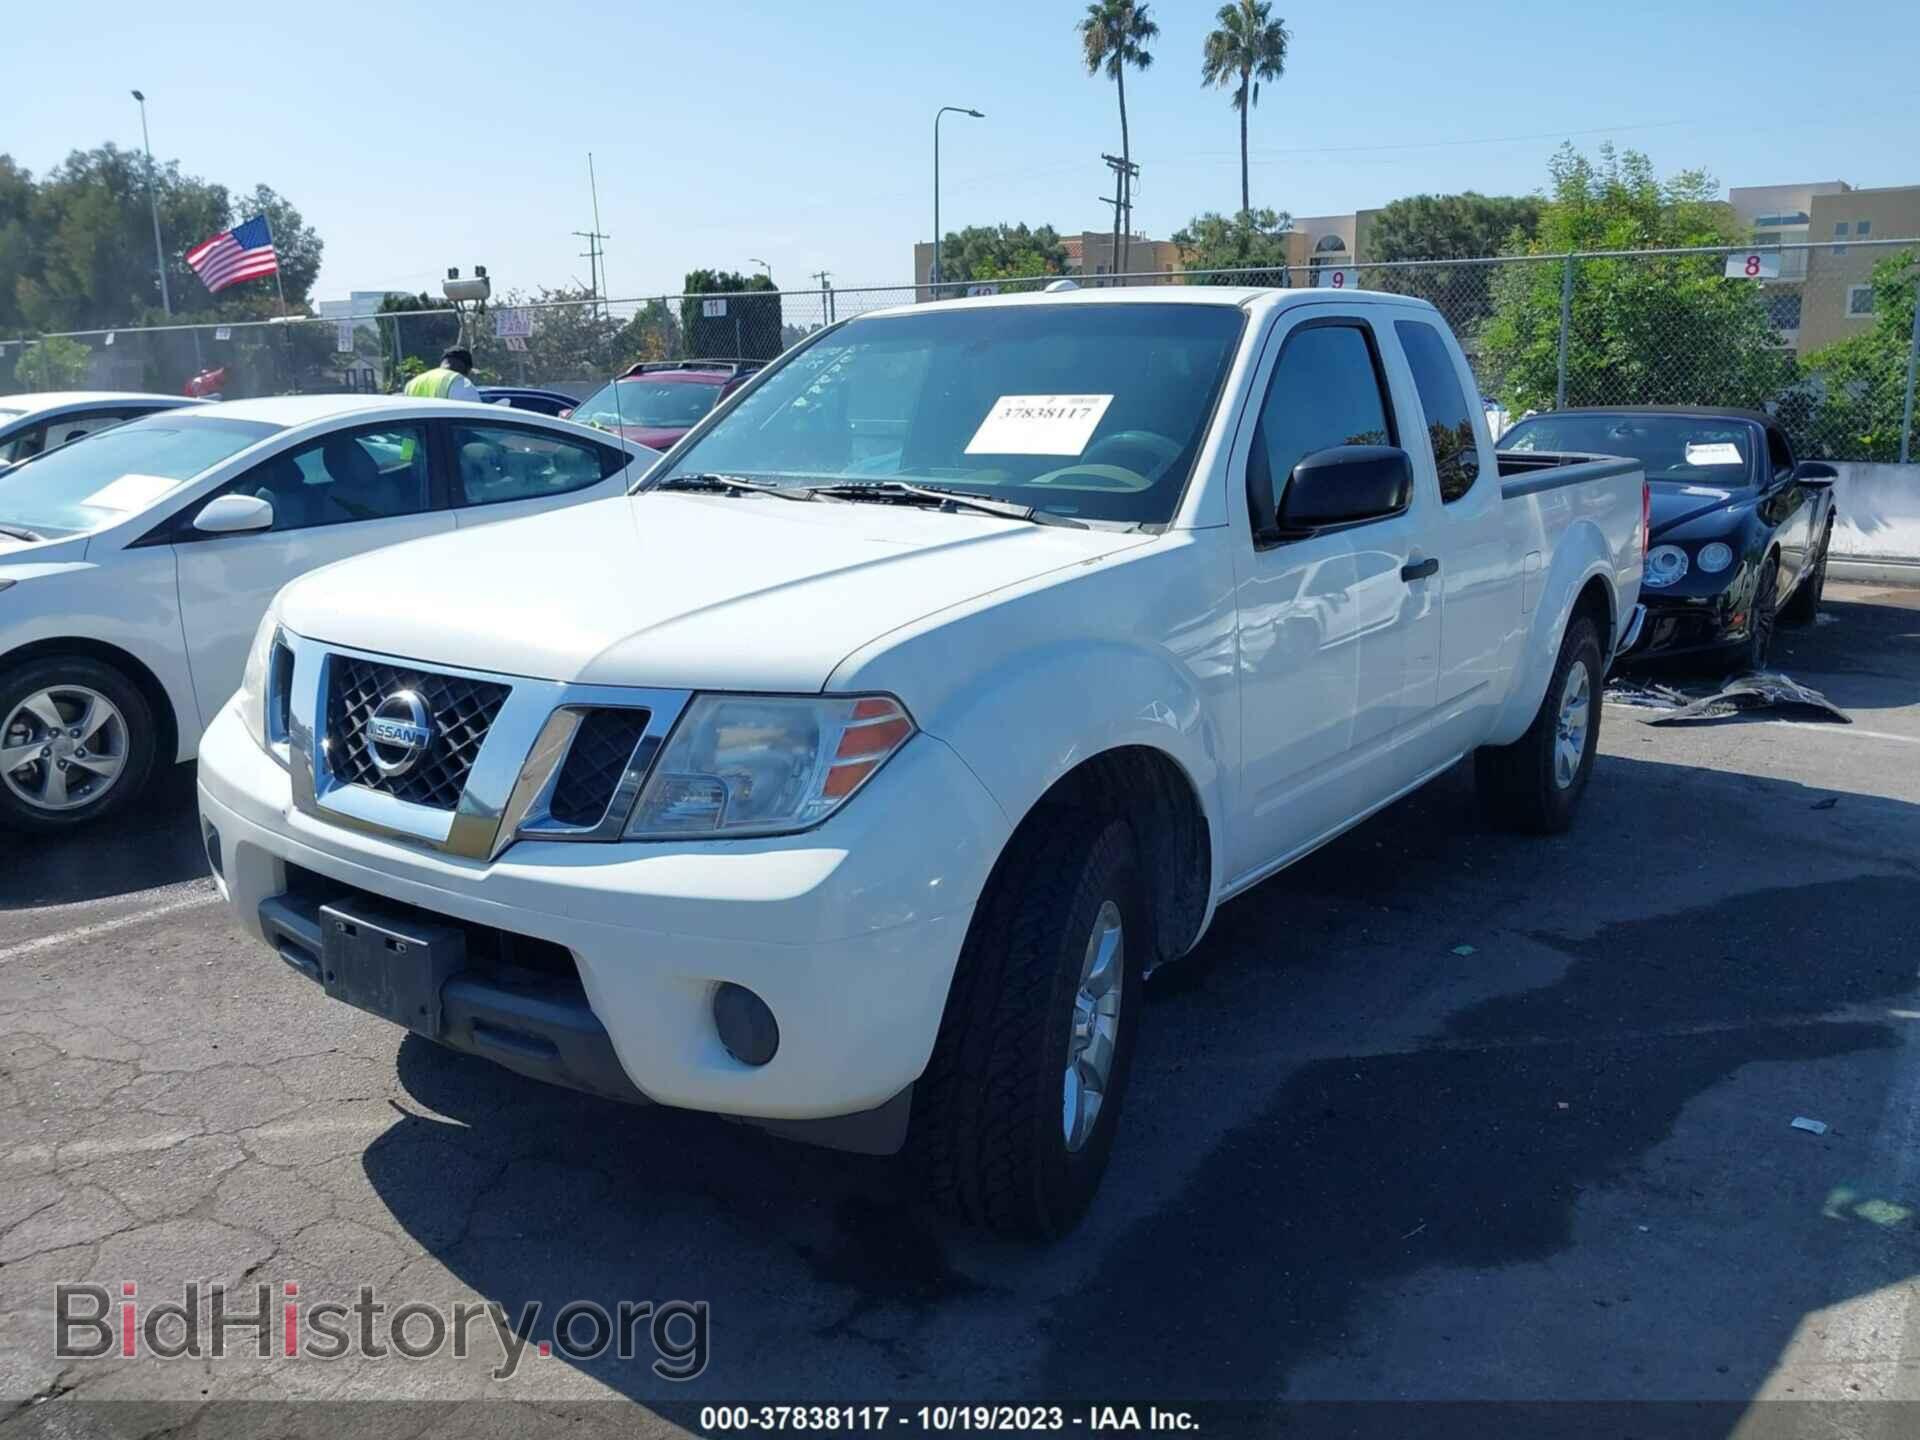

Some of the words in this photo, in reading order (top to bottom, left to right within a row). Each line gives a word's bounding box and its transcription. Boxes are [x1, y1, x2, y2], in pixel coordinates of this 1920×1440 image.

[1745, 255, 1760, 275] 8
[1332, 272, 1344, 288] 9
[1000, 408, 1091, 419] 37838117
[368, 724, 416, 742] NISSAN
